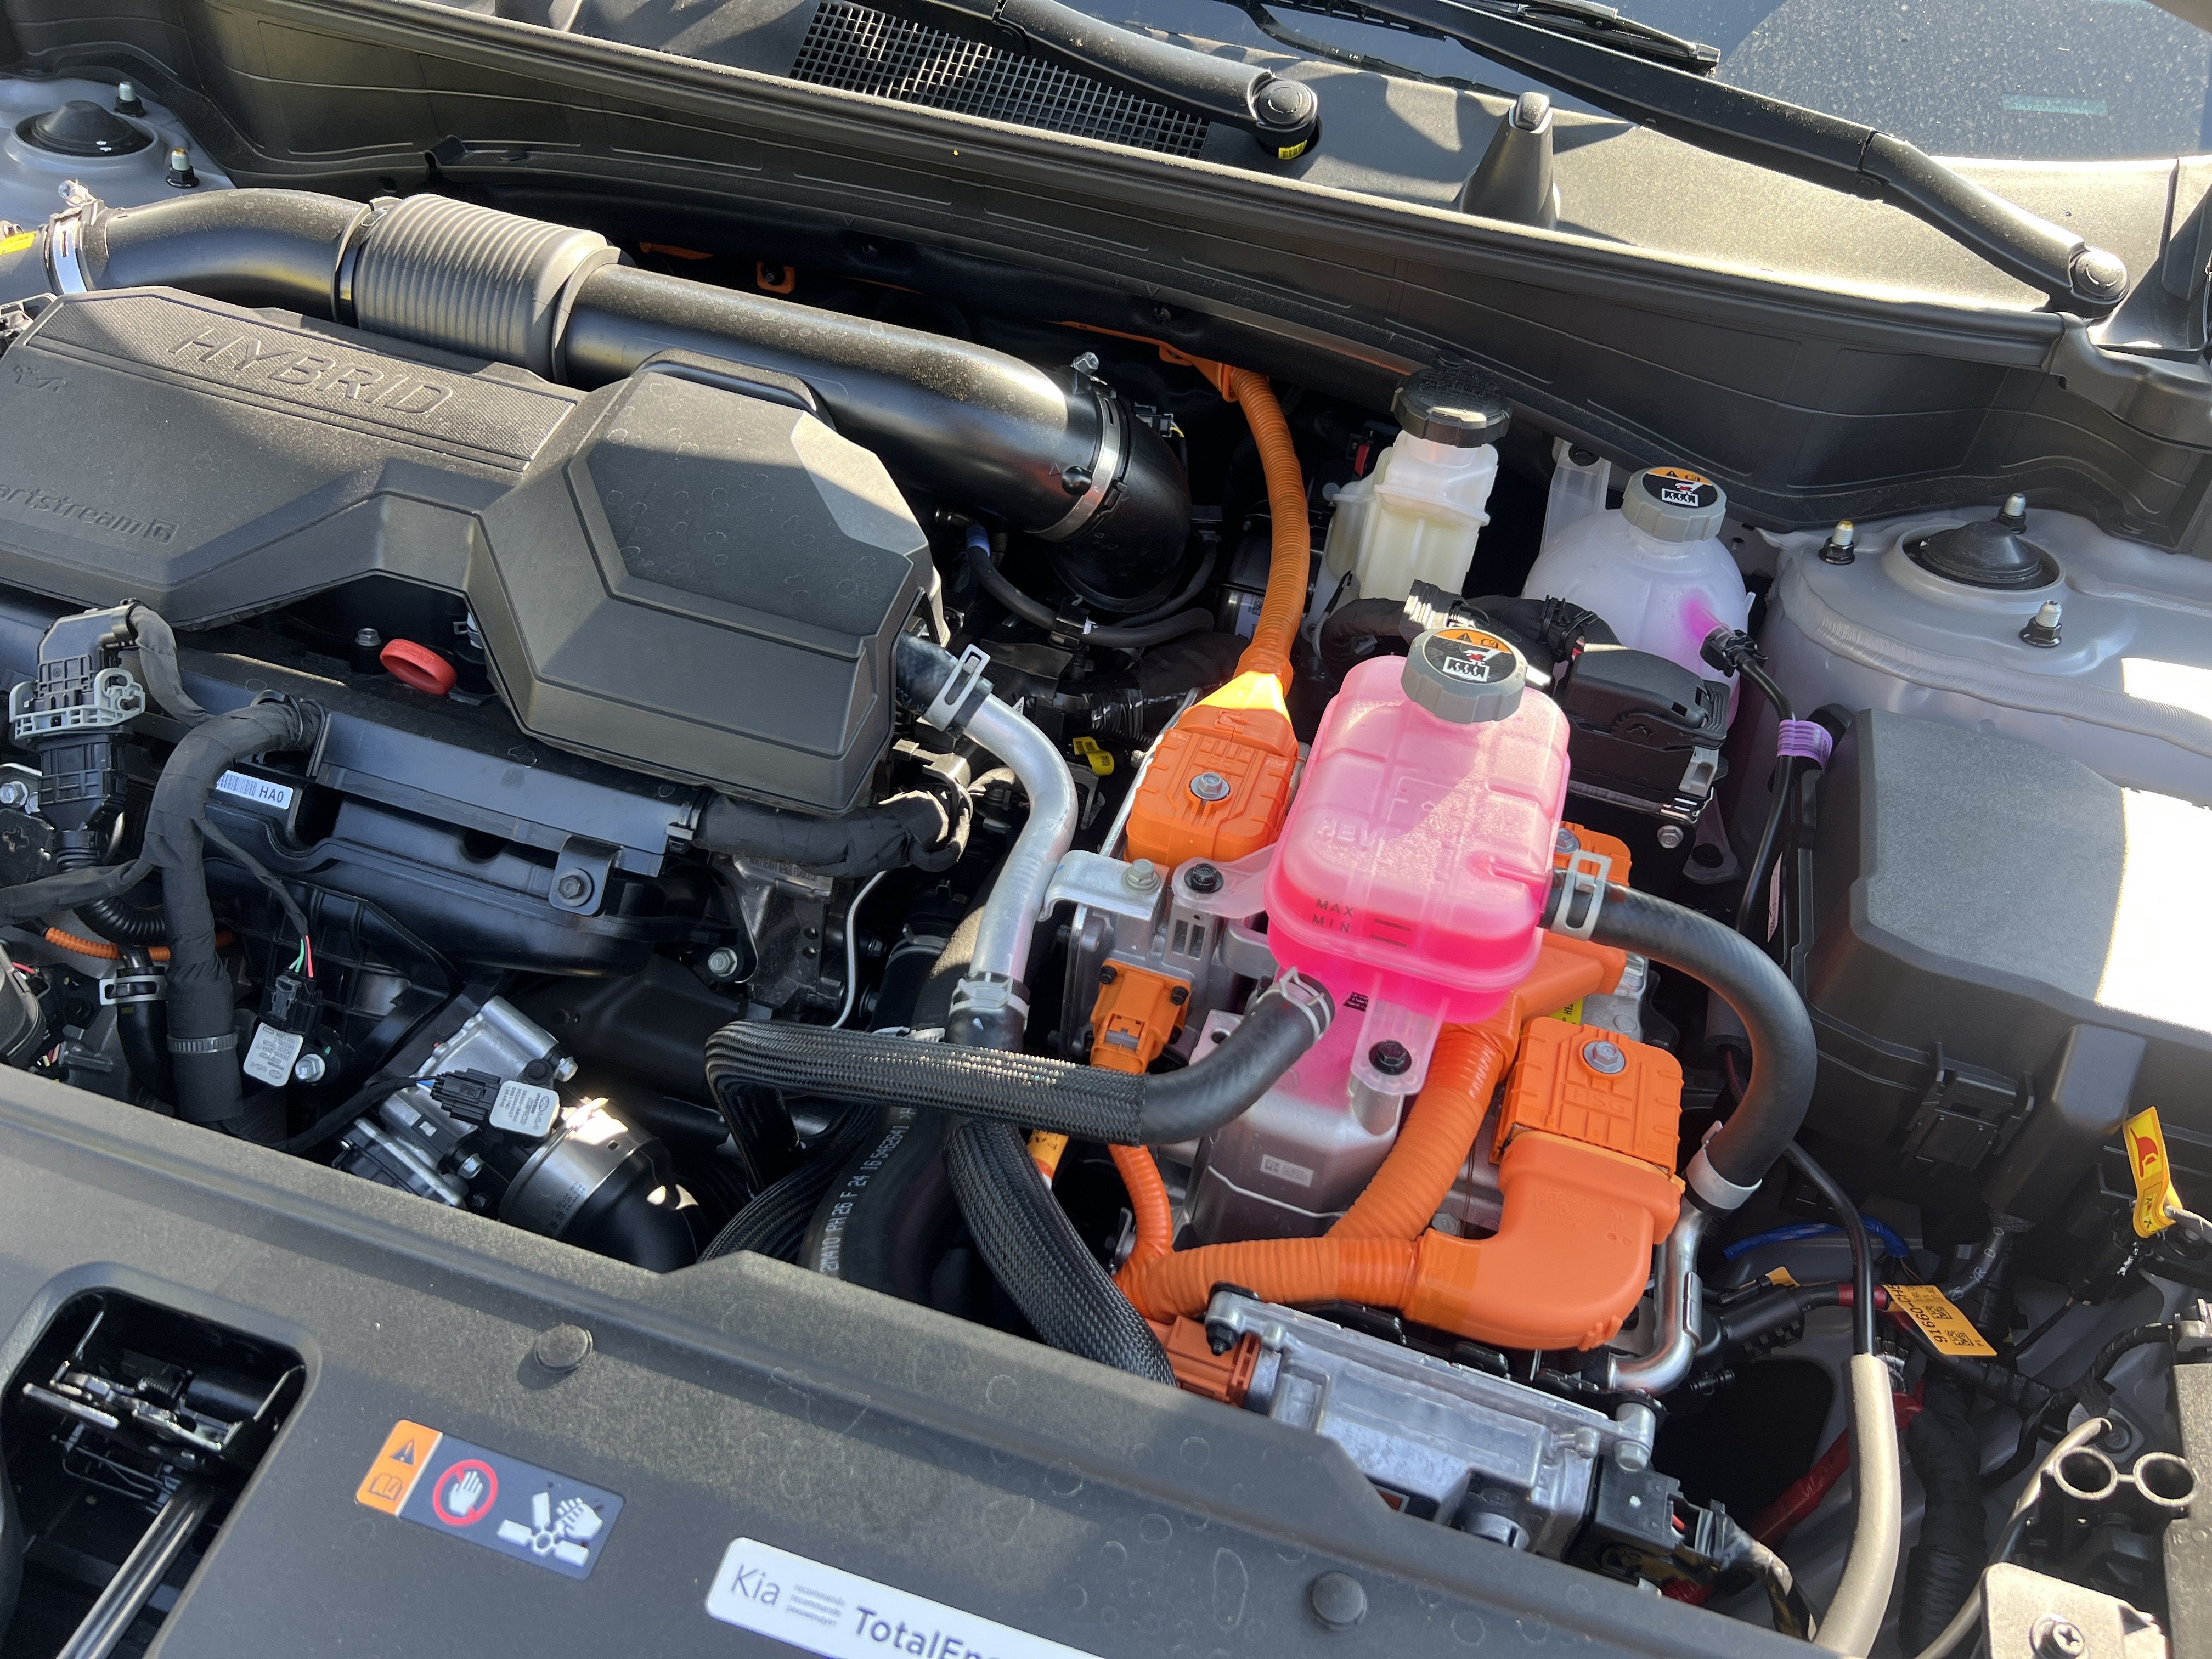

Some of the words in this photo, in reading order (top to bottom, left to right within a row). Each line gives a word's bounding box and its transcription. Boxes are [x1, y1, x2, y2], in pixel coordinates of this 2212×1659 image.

[167, 328, 453, 414] HYBRID
[1316, 897, 1355, 917] MAX
[1312, 913, 1351, 933] MIN
[848, 1175, 871, 1187] 24
[1968, 1266, 1987, 1283] YR
[730, 1562, 780, 1606] Kia
[794, 1583, 845, 1607] recommends
[785, 1604, 838, 1628] рекомендует
[790, 1593, 842, 1617] recommande
